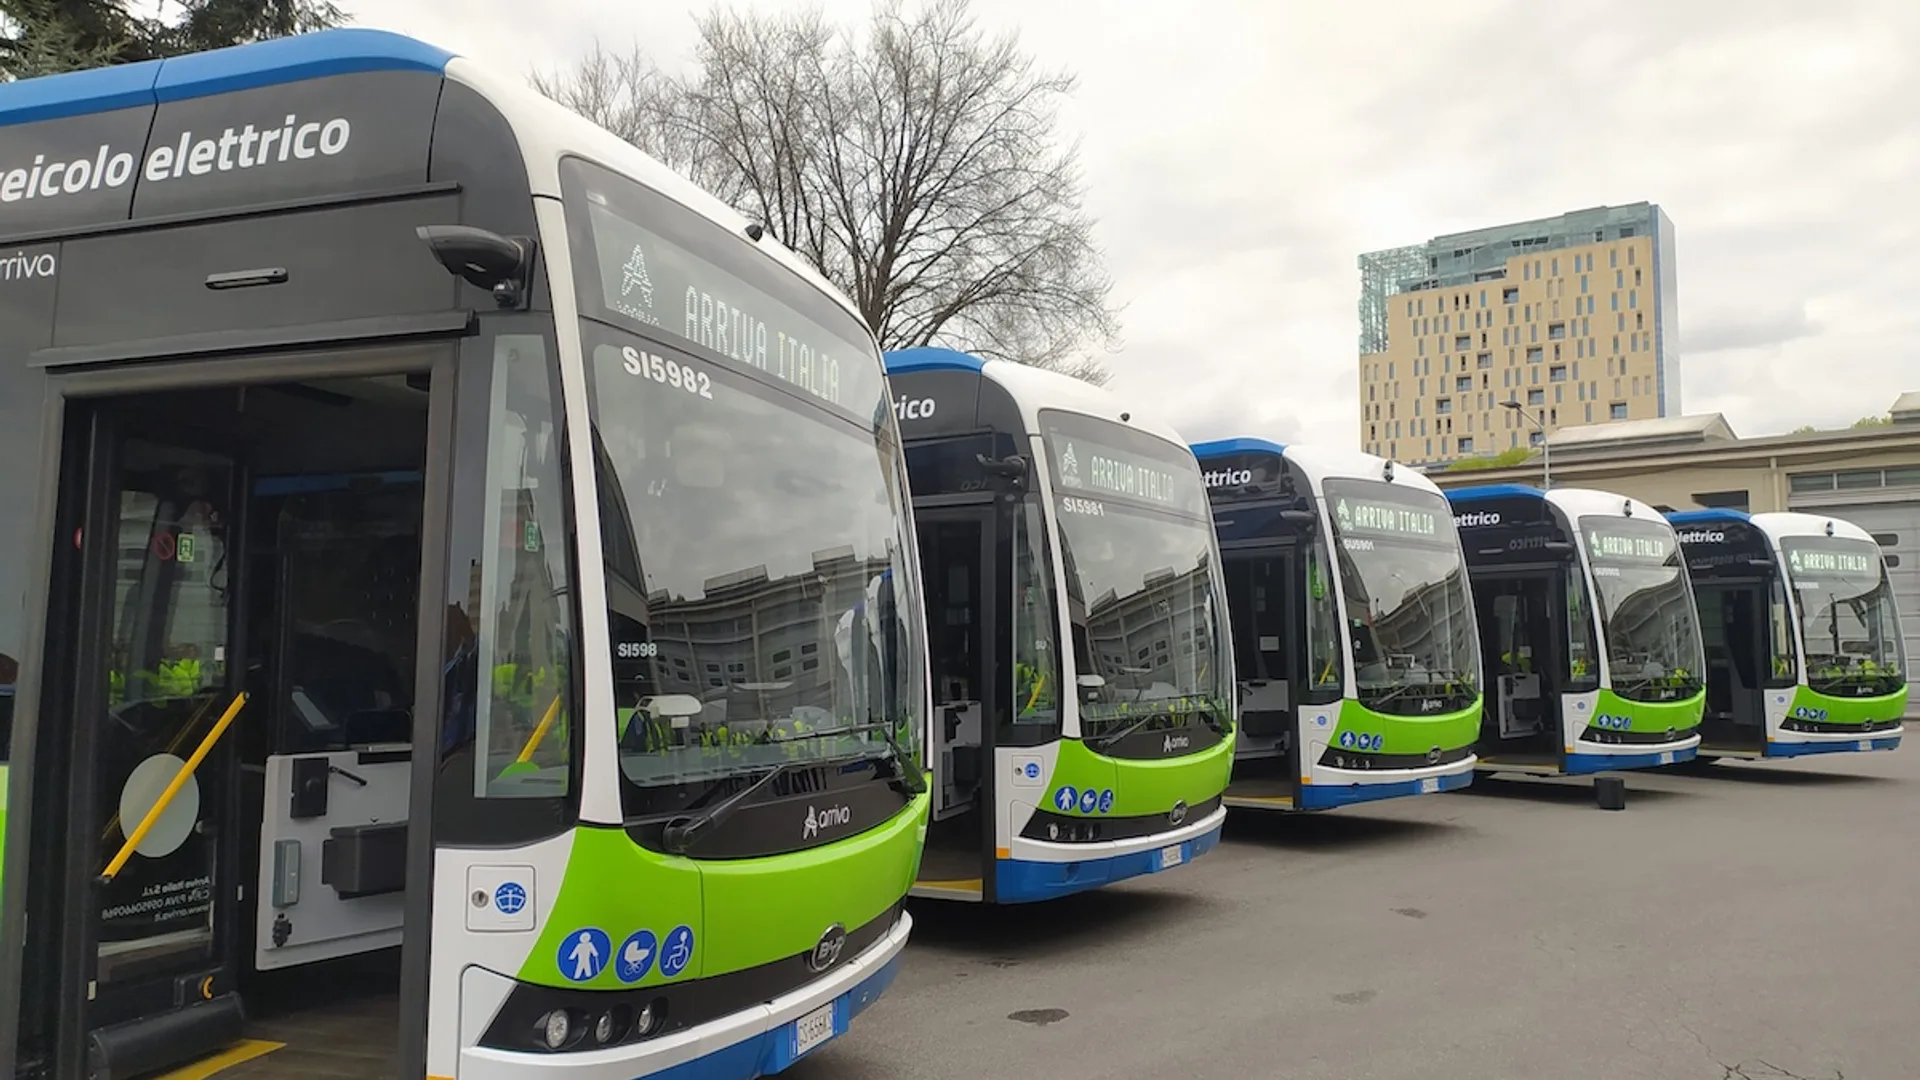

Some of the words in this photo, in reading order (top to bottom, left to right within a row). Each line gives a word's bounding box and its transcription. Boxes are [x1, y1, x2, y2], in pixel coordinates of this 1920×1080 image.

[0, 144, 133, 202] eicolo
[145, 114, 350, 181] elettrico
[685, 285, 768, 371] ARRIVA
[777, 332, 840, 403] ITALIA
[622, 346, 714, 400] SI5982
[1091, 456, 1134, 494] ARRIVA
[1139, 467, 1174, 502] ITALIA
[1202, 468, 1251, 487] ttrico
[1063, 497, 1104, 516] SI5981
[1355, 506, 1394, 530] ARRIVA
[1399, 510, 1434, 534] ITALIA
[1603, 536, 1633, 555] ARRIVA
[1636, 538, 1663, 557] ITALIA
[1675, 530, 1725, 543] lettrico
[1804, 553, 1835, 570] ARRIVA
[1838, 554, 1867, 571] ITALIA
[617, 642, 658, 657] SI598
[818, 804, 850, 828] arriva
